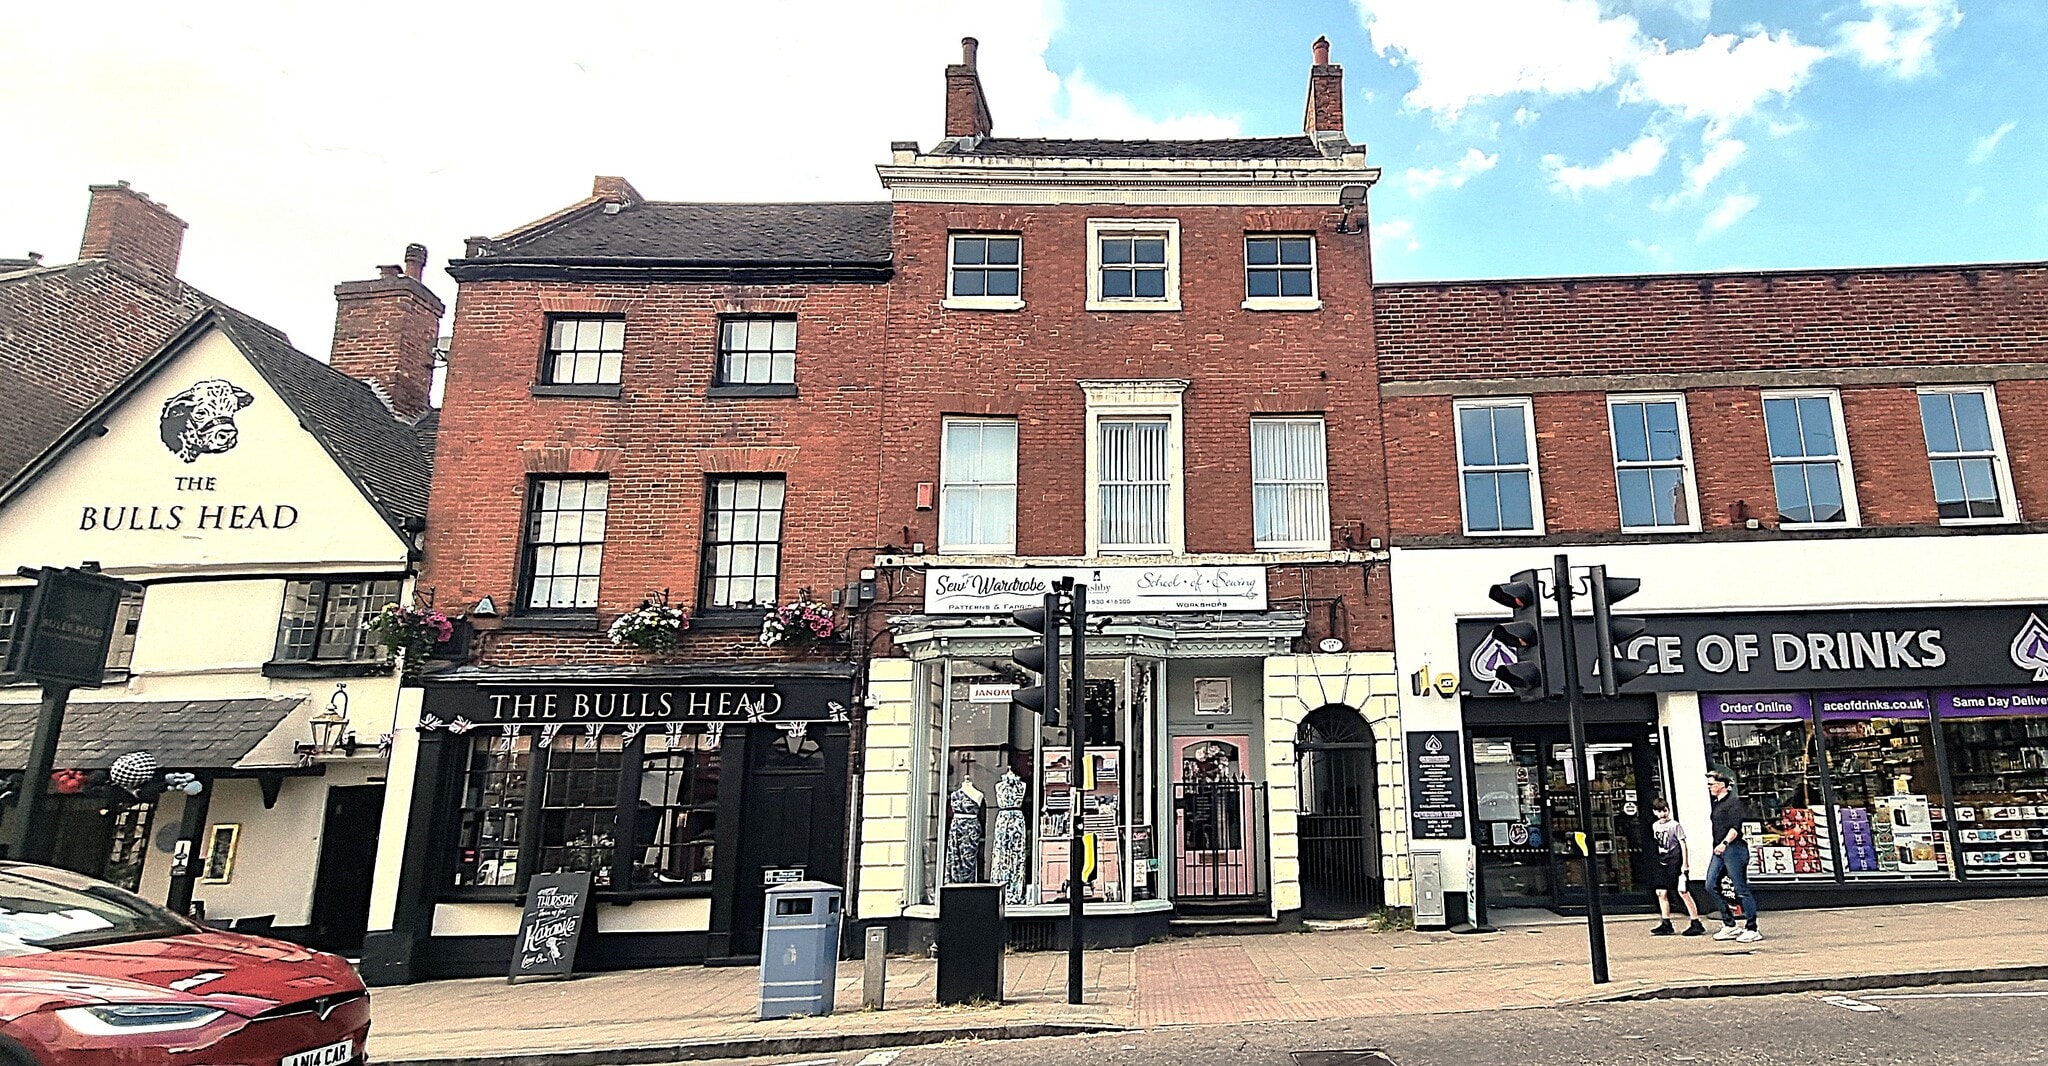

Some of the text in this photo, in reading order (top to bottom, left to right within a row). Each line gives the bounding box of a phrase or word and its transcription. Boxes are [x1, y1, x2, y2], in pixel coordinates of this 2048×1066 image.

[175, 476, 217, 491] THE
[79, 504, 299, 531] BULLS HEAD
[972, 574, 1046, 595] Wardrobe
[1088, 583, 1111, 593] shby
[1137, 569, 1257, 596] School of Sewing
[1696, 634, 1759, 673] OF
[1772, 629, 1946, 672] DRINKS
[975, 689, 1011, 697] JANOM
[490, 692, 782, 719] THE BULLS HEAD
[1720, 701, 1793, 713] Order Online
[1823, 699, 1925, 712] aceofdrinks.co.uk
[1952, 696, 1985, 707] Same
[1987, 696, 2010, 709] Day
[536, 894, 579, 909] THURSDAY
[521, 917, 577, 953] Karaoke
[325, 1045, 347, 1065] CAR
